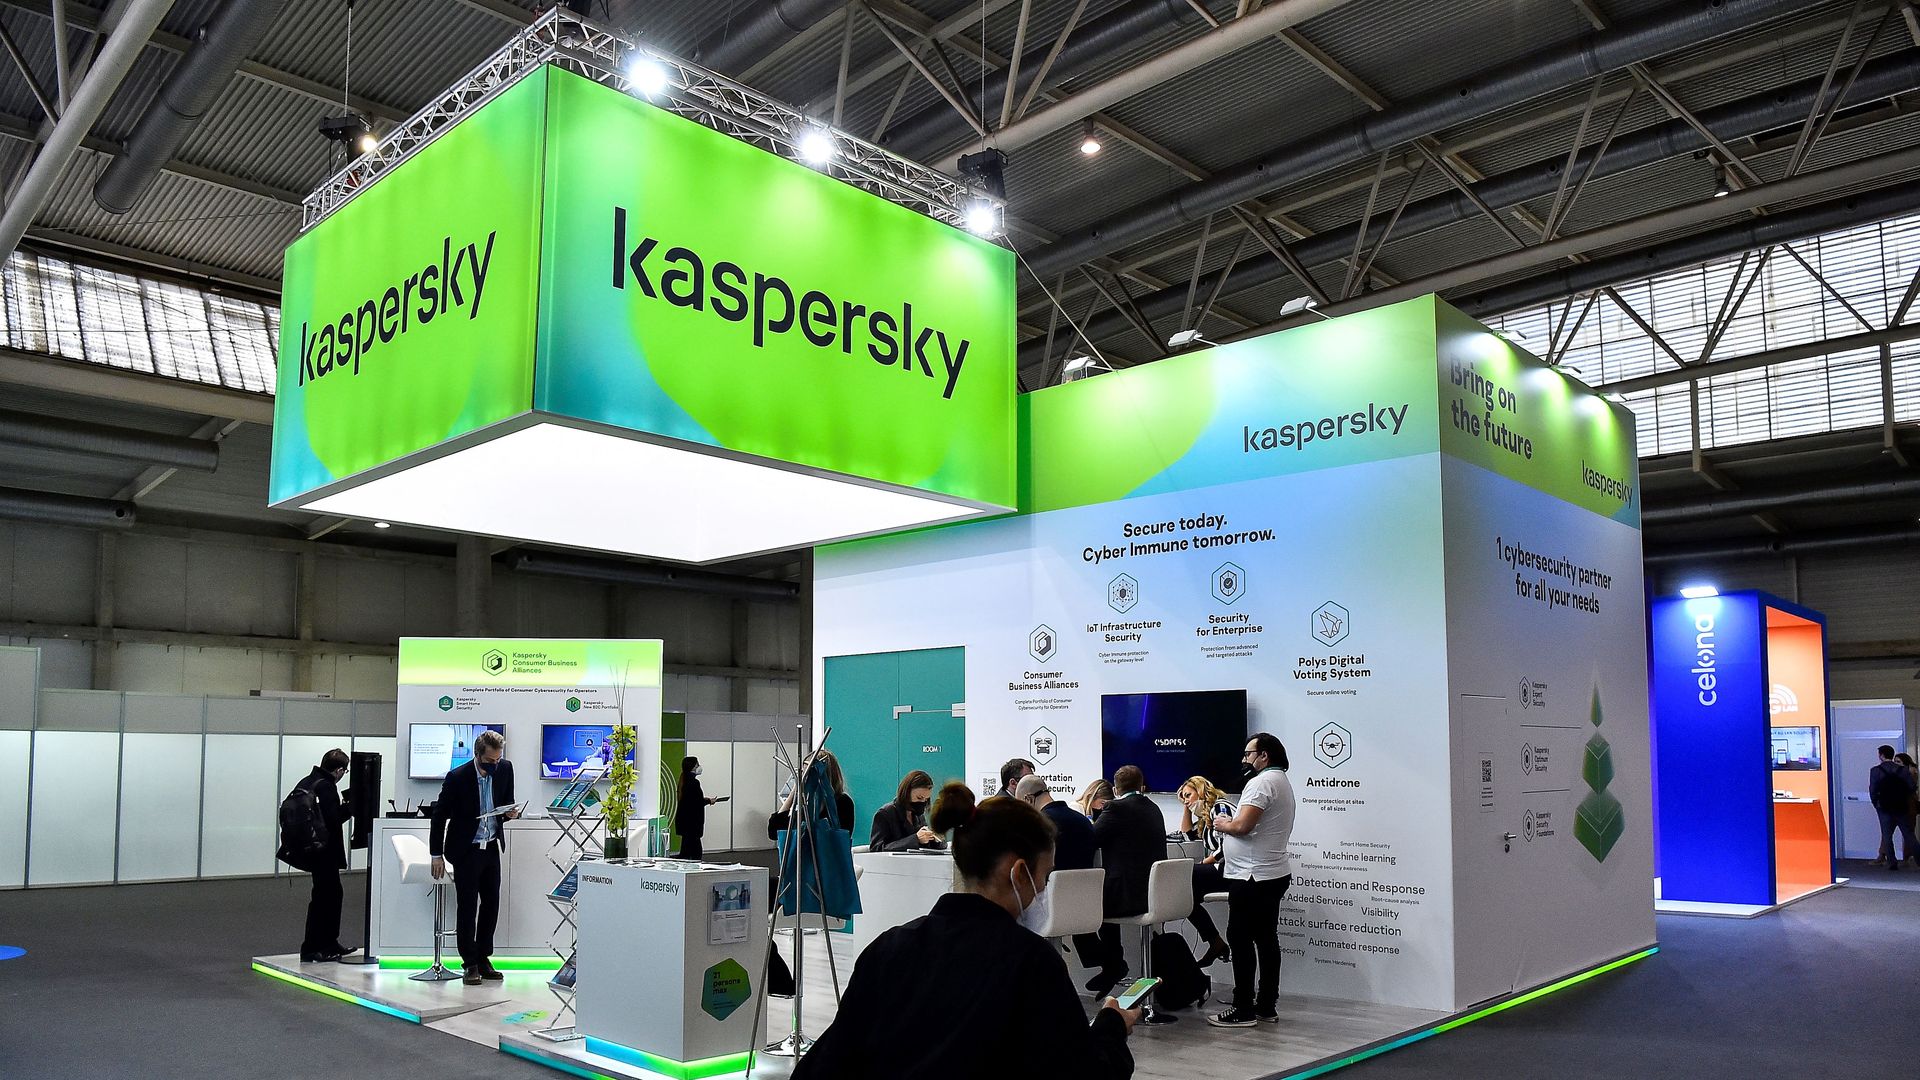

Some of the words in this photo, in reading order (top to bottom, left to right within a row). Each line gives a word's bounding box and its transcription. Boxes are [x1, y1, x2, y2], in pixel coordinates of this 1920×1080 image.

[299, 231, 497, 387] kaspersky
[612, 206, 970, 399] kaspersky
[1450, 357, 1494, 411] Bring
[1499, 387, 1517, 414] on
[1244, 403, 1409, 452] kaspersky
[1451, 400, 1480, 437] the
[1484, 412, 1533, 459] future
[1581, 460, 1633, 509] kaspersky
[1123, 521, 1175, 538] Secure
[1179, 513, 1228, 531] today.
[1082, 545, 1126, 564] Cyber
[1130, 537, 1189, 556] Immune
[1192, 529, 1276, 548] tomorrow.
[1496, 536, 1502, 560] 1
[1504, 542, 1576, 587] cybersecurity
[1578, 565, 1612, 590] partner
[1515, 573, 1532, 597] for
[1534, 579, 1546, 602] all
[1549, 587, 1571, 609] your
[1572, 592, 1600, 614] needs
[1086, 624, 1099, 632] IoT
[1100, 620, 1162, 632] Infrastructure
[1208, 613, 1249, 624] Security
[1105, 632, 1142, 643] Security
[1196, 627, 1210, 637] for
[1212, 624, 1263, 636] Enterprise
[1298, 657, 1327, 668] Polys
[1329, 654, 1364, 668] Digital
[1691, 613, 1717, 706] celona
[1023, 671, 1063, 679] Consumer
[1293, 669, 1327, 681] Voting
[1330, 669, 1371, 680] System
[1008, 682, 1042, 691] Business
[1044, 681, 1079, 689] Alliances
[1048, 784, 1076, 795] ecurity
[1306, 777, 1360, 788] Antidrone
[1322, 850, 1359, 861] Machine
[1361, 853, 1396, 865] learning
[582, 874, 613, 885] INFORMATION
[640, 878, 680, 896] kaspersky
[1296, 876, 1347, 890] Detection
[1350, 880, 1369, 891] and
[1372, 881, 1425, 895] Response
[1287, 893, 1315, 903] Added
[1316, 895, 1354, 906] Services
[1361, 906, 1399, 920] Visibility
[1279, 916, 1305, 927] ttack
[1308, 920, 1347, 931] surface
[1349, 923, 1402, 936] reduction
[1308, 937, 1357, 950] Automated
[1358, 944, 1400, 954] response
[1315, 957, 1331, 965] System
[1332, 959, 1356, 968] Hardening
[713, 979, 741, 988] persons
